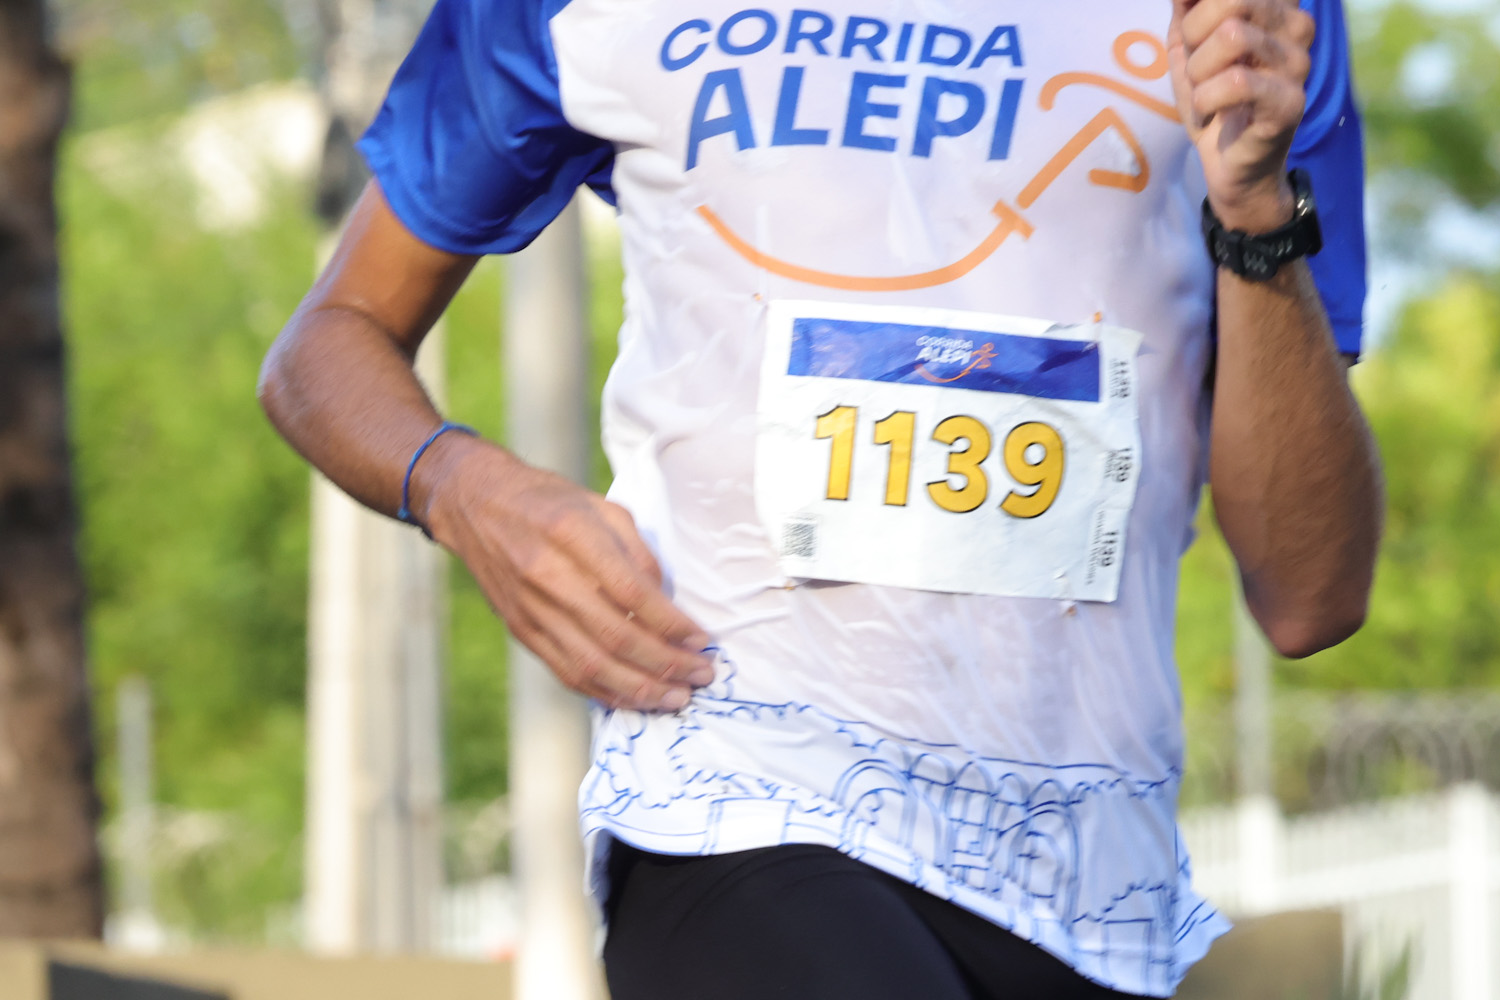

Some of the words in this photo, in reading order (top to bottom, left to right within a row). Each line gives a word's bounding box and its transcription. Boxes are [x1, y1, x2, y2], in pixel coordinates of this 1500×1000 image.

[659, 8, 1025, 72] CORRIDA
[684, 66, 1026, 173] ALEPI
[915, 346, 973, 366] ALEPI
[814, 404, 1066, 519] 1139
